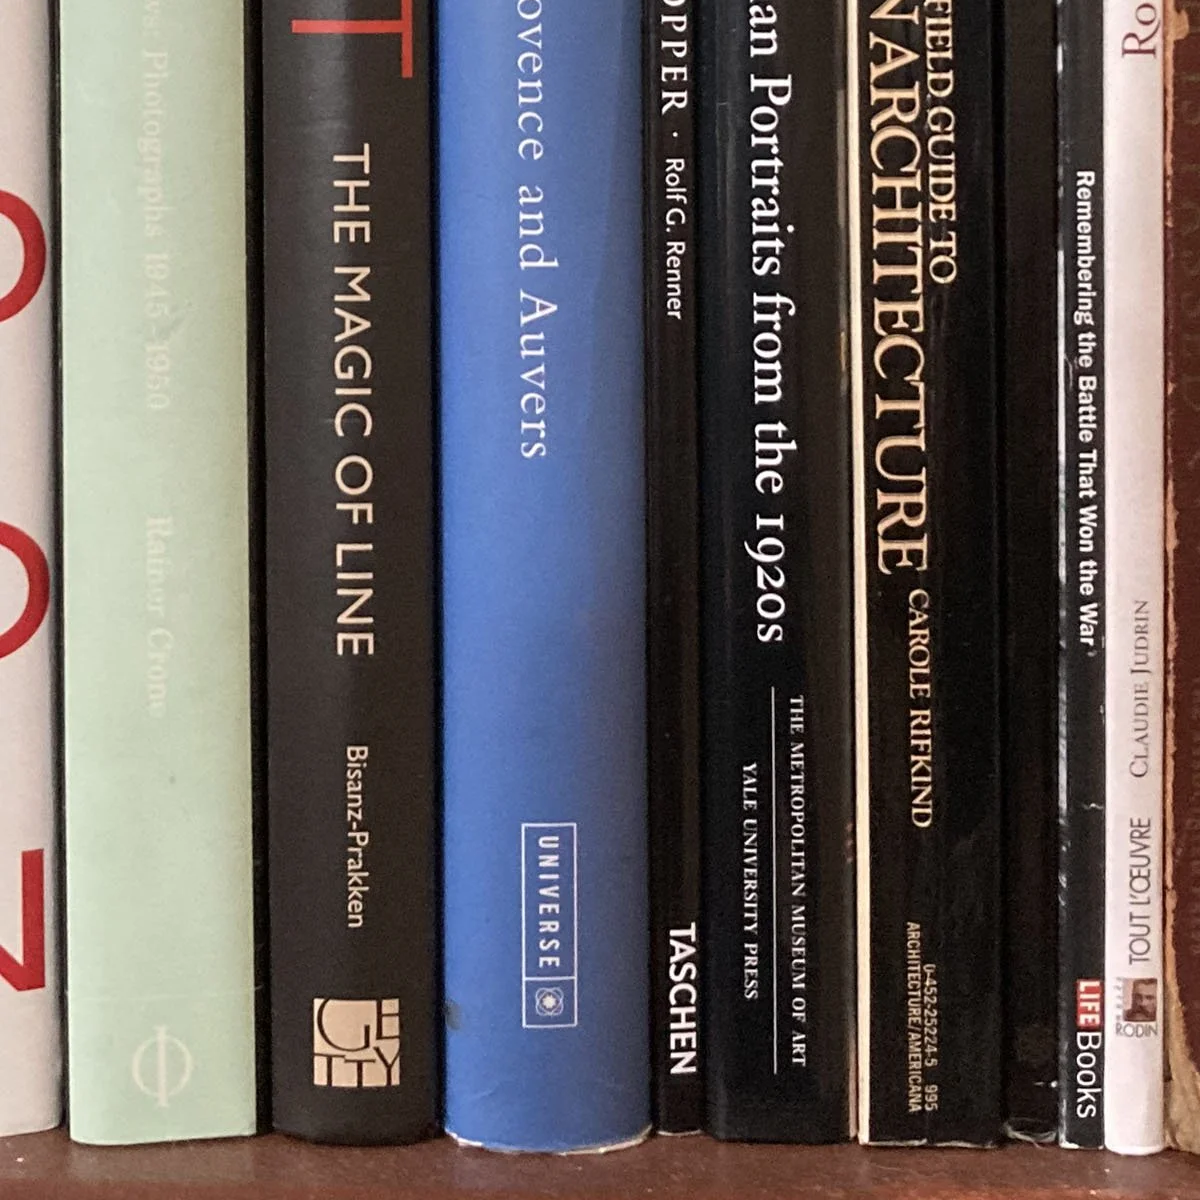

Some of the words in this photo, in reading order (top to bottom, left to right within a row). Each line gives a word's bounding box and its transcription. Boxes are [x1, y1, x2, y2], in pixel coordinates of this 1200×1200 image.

[137, 49, 171, 237] Photographs
[665, 158, 686, 203] Rolf
[750, 74, 794, 275] Portraits
[927, 106, 957, 222] GUIDE
[332, 143, 373, 244] THE
[519, 184, 559, 270] and
[666, 208, 685, 233] G.
[665, 241, 686, 319] Renner
[928, 232, 958, 283] TO
[1073, 171, 1097, 325] Remembering
[867, 31, 930, 575] ARCHITECTURE
[333, 266, 374, 438] MAGIC
[519, 289, 559, 460] Auvers
[753, 292, 795, 404] from
[1077, 332, 1096, 368] the
[1078, 376, 1098, 442] Battle
[333, 454, 374, 527] OF
[754, 421, 797, 493] the
[1079, 449, 1098, 498] That
[144, 515, 173, 618] Rainer
[1079, 505, 1098, 552] Won
[335, 543, 376, 656] LINE
[744, 514, 788, 641] 1920s
[1079, 559, 1099, 595] the
[144, 627, 173, 716] Crone
[907, 588, 932, 699] CAROLE
[1130, 600, 1151, 674] JUDRIN
[789, 695, 805, 734] THE
[1129, 684, 1151, 778] CLAUDIE
[742, 762, 758, 810] YALE
[909, 708, 932, 828] RIFKIND
[343, 746, 371, 929] Bisanz-Prakken
[789, 742, 806, 896] METROPOLITAN
[539, 836, 559, 968] UNIVERSE
[743, 819, 758, 933] UNIVERSITY
[743, 943, 758, 999] PRESS
[790, 905, 806, 988] MUSEUM
[1129, 912, 1150, 965] TOUT
[669, 922, 697, 1075] TASCHEN
[791, 997, 807, 1021] OF
[905, 922, 923, 1112] ARCHITECTURE/AMERICANA
[1079, 981, 1100, 1025] LIFE
[1116, 1023, 1158, 1038] RODIN
[791, 1031, 807, 1066] ART
[1077, 1032, 1102, 1118] Books
[923, 1084, 938, 1111] 995
